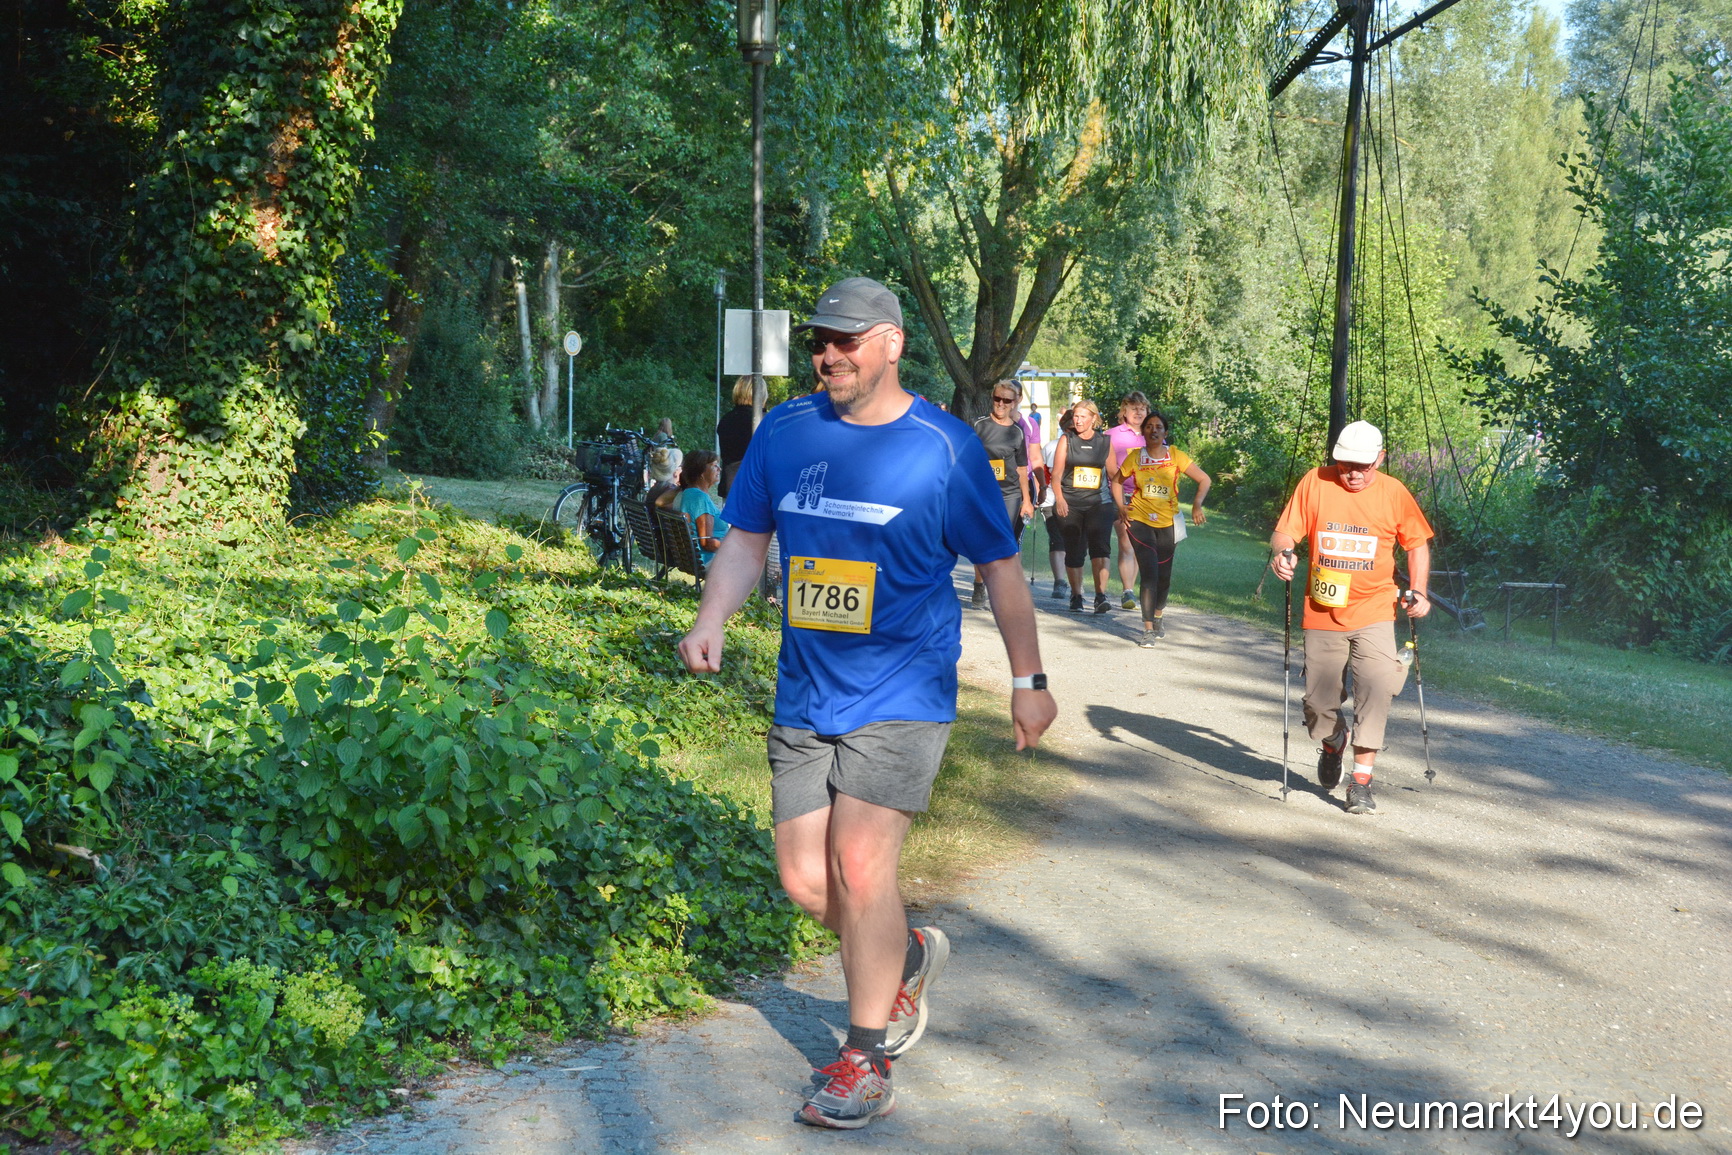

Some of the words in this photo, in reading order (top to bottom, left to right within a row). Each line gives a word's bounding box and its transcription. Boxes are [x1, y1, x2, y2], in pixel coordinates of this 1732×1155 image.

[1146, 484, 1168, 495] 1323
[822, 508, 855, 518] Neumarkt
[824, 501, 884, 515] Schornsteintechnik
[1326, 522, 1341, 531] 30
[1343, 524, 1368, 534] Jahre
[1321, 536, 1372, 554] OBI
[1317, 554, 1375, 571] Neumarkt
[1314, 578, 1337, 597] 890
[797, 582, 860, 612] 1786
[801, 608, 821, 617] Bayerl
[822, 610, 849, 619] Michael
